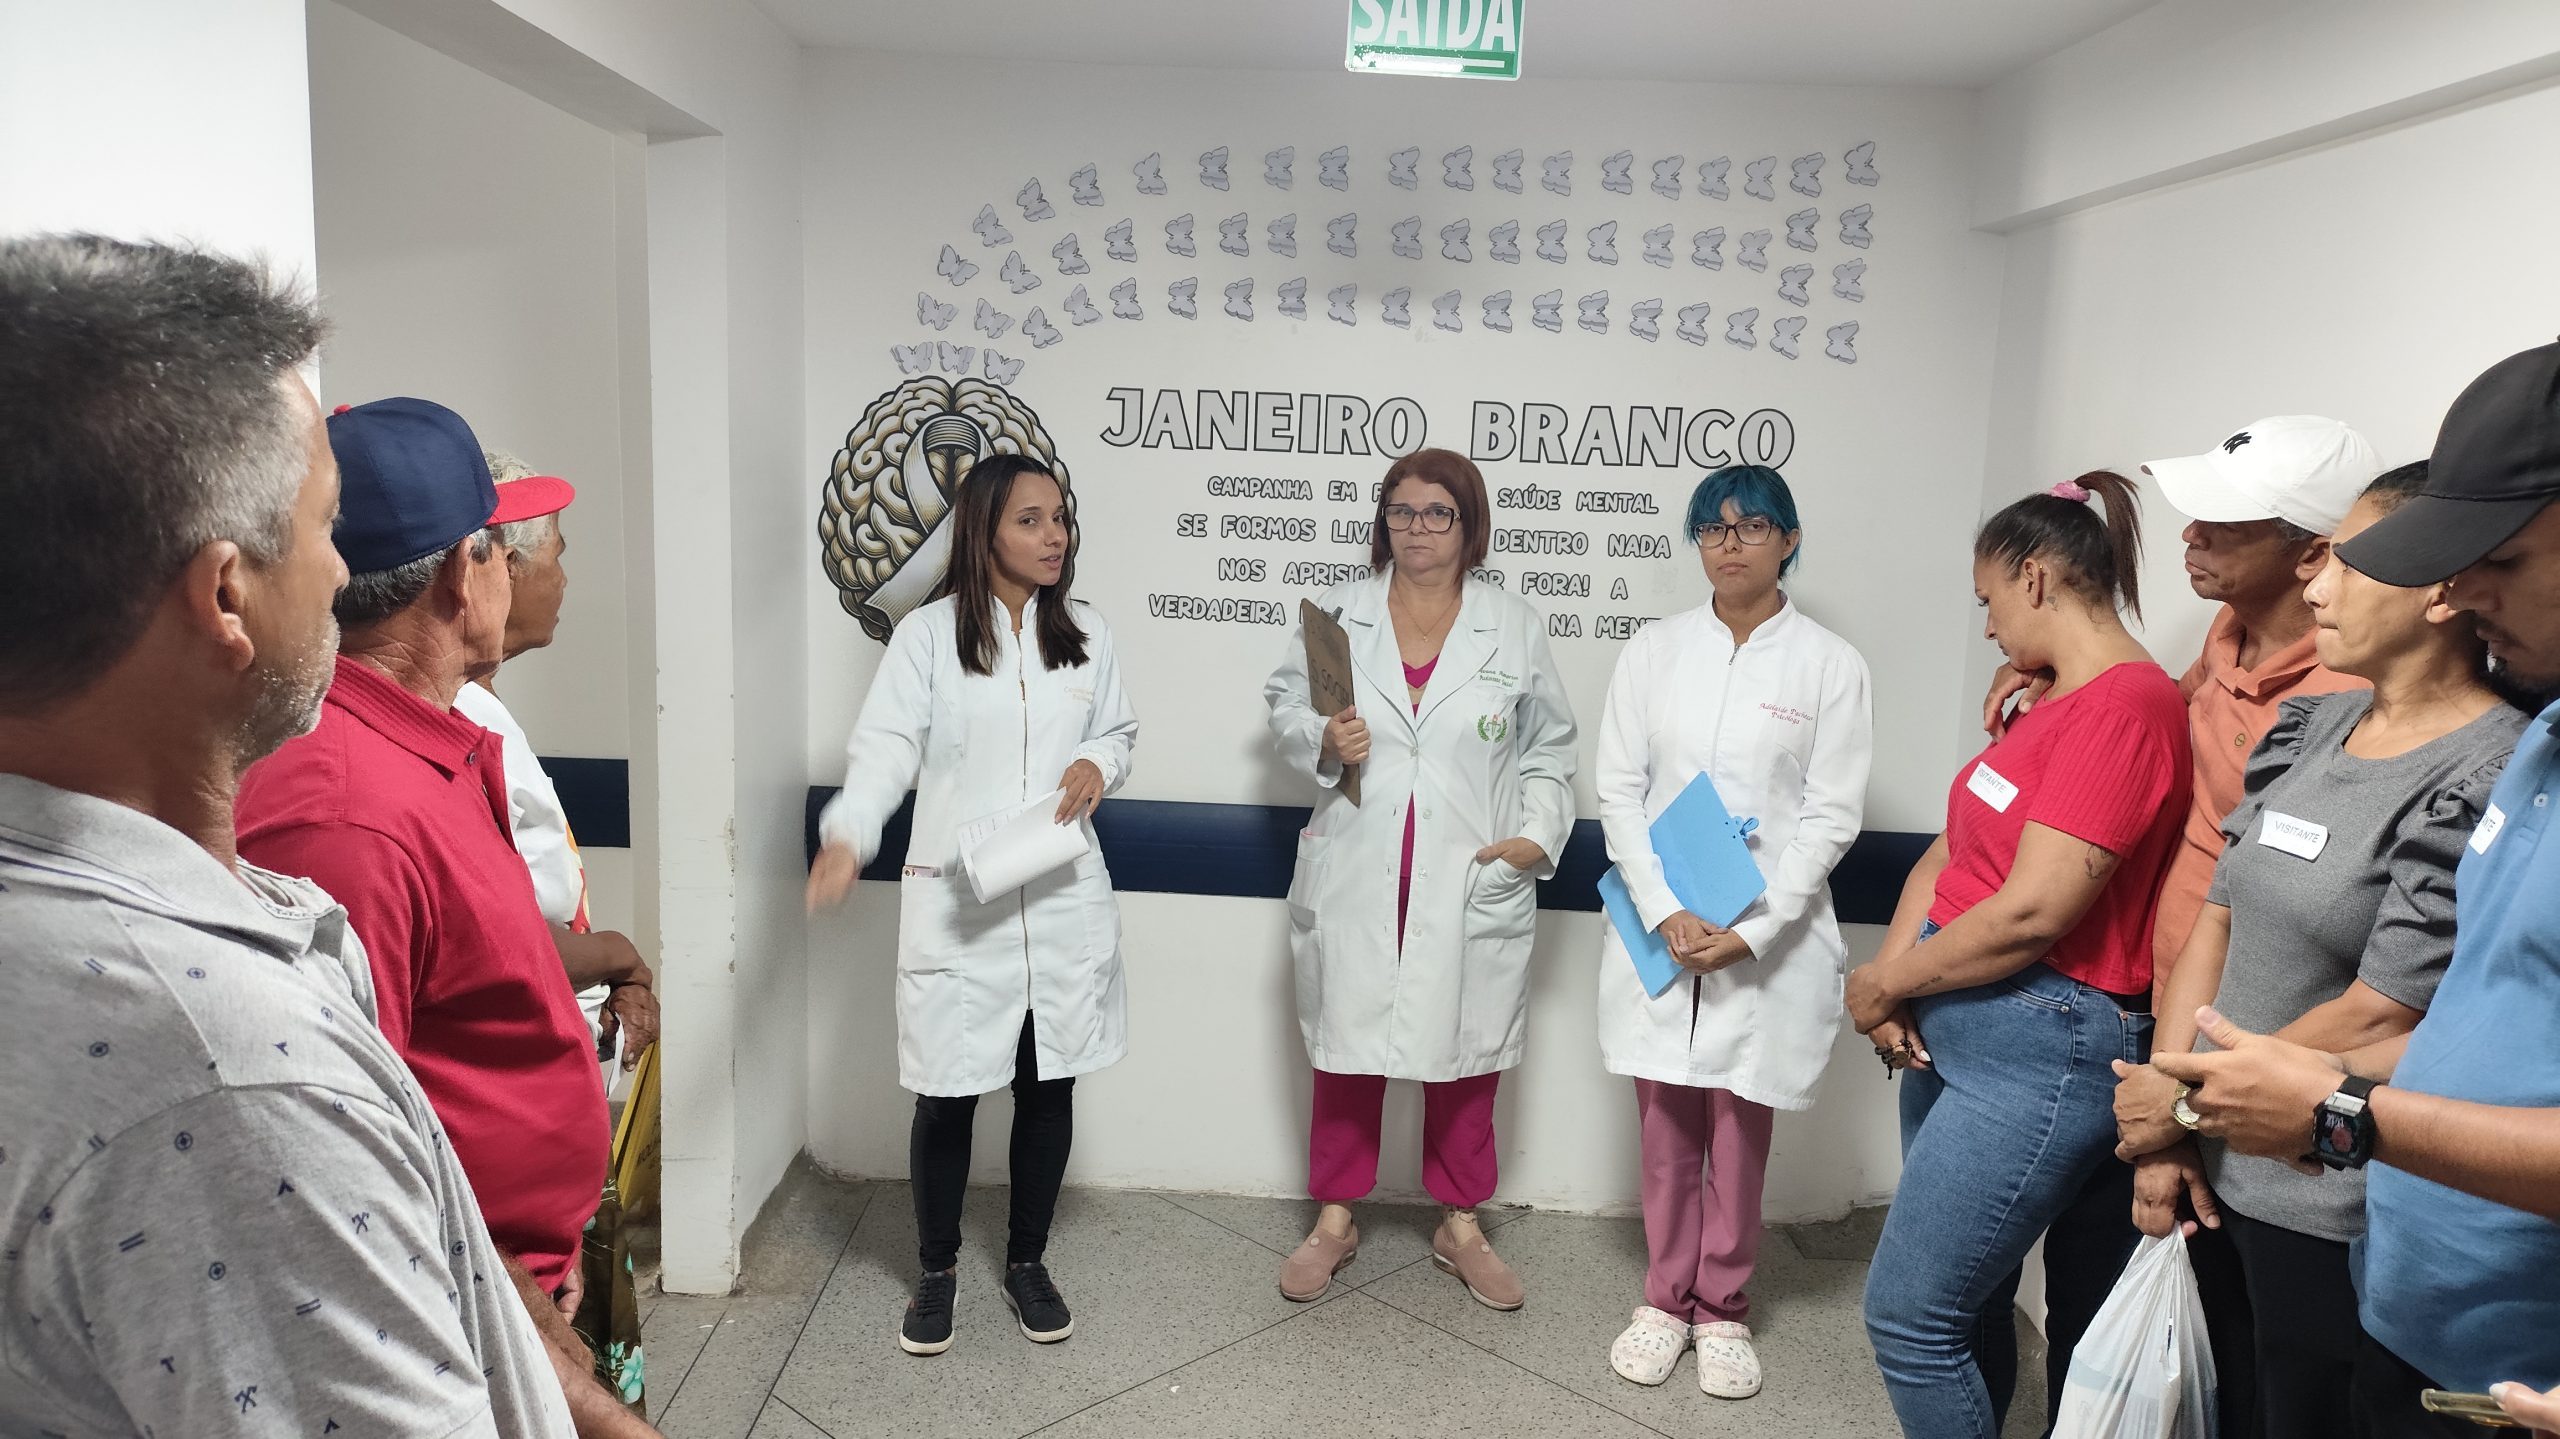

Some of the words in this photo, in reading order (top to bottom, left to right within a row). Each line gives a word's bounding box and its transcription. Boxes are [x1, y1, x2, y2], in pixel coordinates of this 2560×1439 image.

[1100, 387, 1427, 459] JANEIRO
[1470, 400, 1795, 470] BRANCO
[1208, 475, 1313, 501] CAMPANHA
[1328, 480, 1358, 502] EM
[1497, 483, 1561, 511] SAÚDE
[1576, 490, 1659, 514] MENTAL
[1177, 513, 1208, 538] SE
[1220, 515, 1317, 542] FORMOS
[1493, 529, 1589, 556] DENTRO
[1607, 534, 1672, 559] NADA
[1218, 558, 1266, 582] NOS
[1521, 572, 1591, 597] FORA!
[1610, 577, 1629, 600] A
[1148, 594, 1286, 626] VERDADEIRA
[1549, 614, 1582, 638] NA
[2275, 820, 2320, 843] VISITANTE
